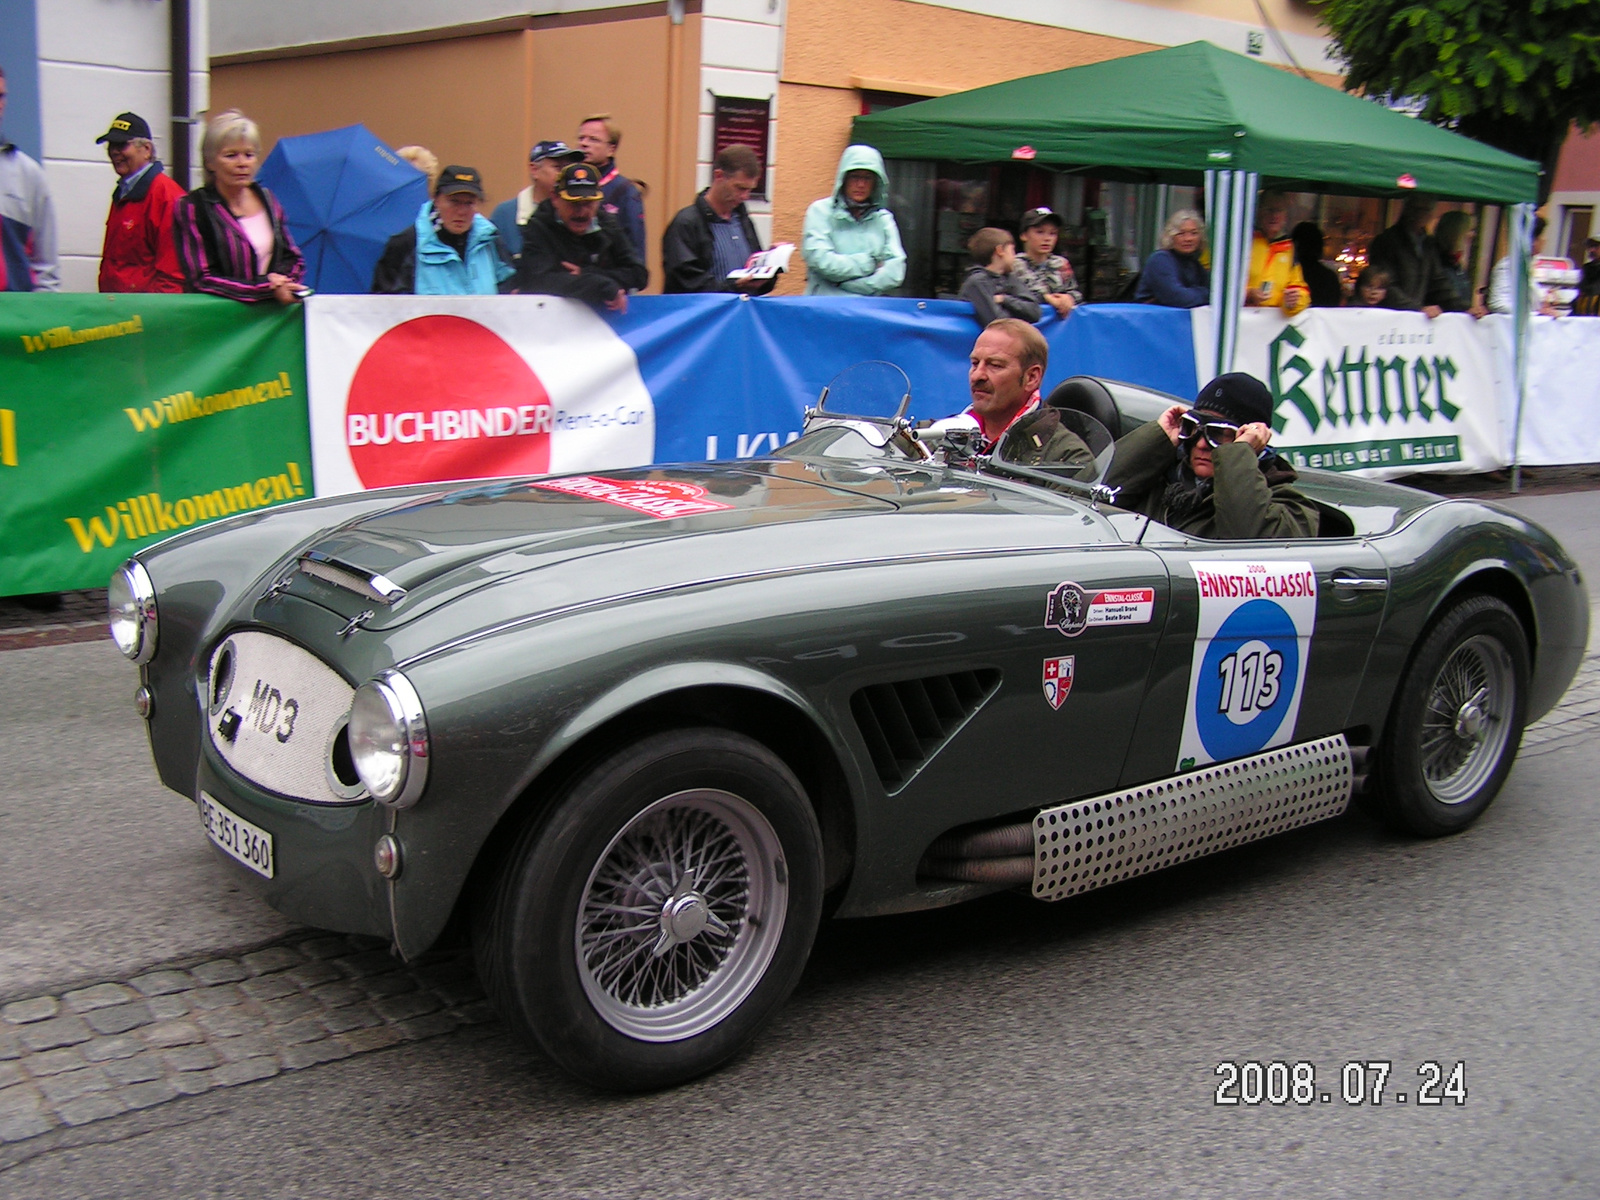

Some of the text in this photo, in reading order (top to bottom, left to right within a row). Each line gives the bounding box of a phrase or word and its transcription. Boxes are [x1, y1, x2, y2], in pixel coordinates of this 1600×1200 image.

[20, 314, 144, 353] Willkommen!
[1378, 328, 1434, 345] eduard
[122, 371, 294, 433] Willkommen!
[1269, 325, 1461, 434] Kettner
[347, 404, 552, 446] BUCHBINDER
[1399, 442, 1456, 461] Natur
[64, 461, 306, 553] Willkommen!
[1197, 570, 1314, 597] ENNSTAL-CLASSIC
[1218, 650, 1283, 714] 113
[248, 679, 299, 744] MD3
